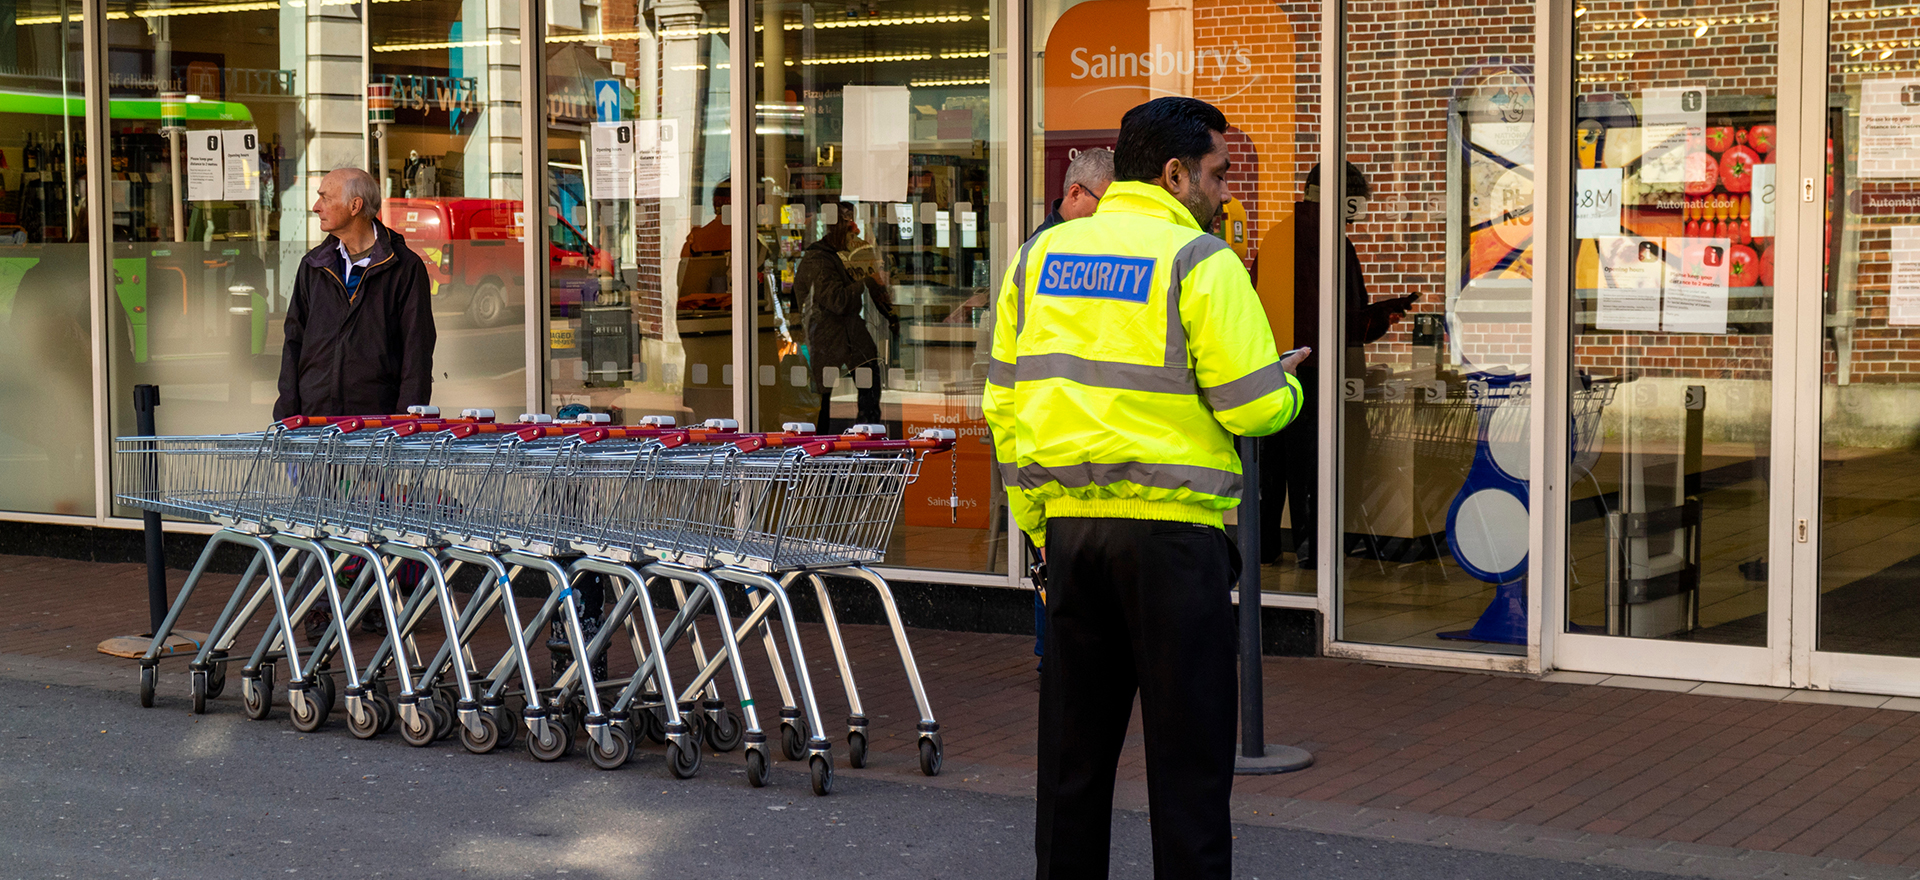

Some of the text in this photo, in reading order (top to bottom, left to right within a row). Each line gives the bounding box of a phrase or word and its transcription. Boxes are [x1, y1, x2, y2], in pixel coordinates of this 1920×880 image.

[1070, 40, 1252, 81] Sainsbury's
[803, 89, 824, 101] Fizzy
[547, 86, 597, 126] pirit
[1656, 199, 1736, 210] Automatic door
[1869, 197, 1920, 208] Automati
[1503, 209, 1534, 227] NO
[1045, 260, 1149, 294] SECURITY
[933, 413, 960, 424] Food
[927, 496, 977, 509] Sainsury's
